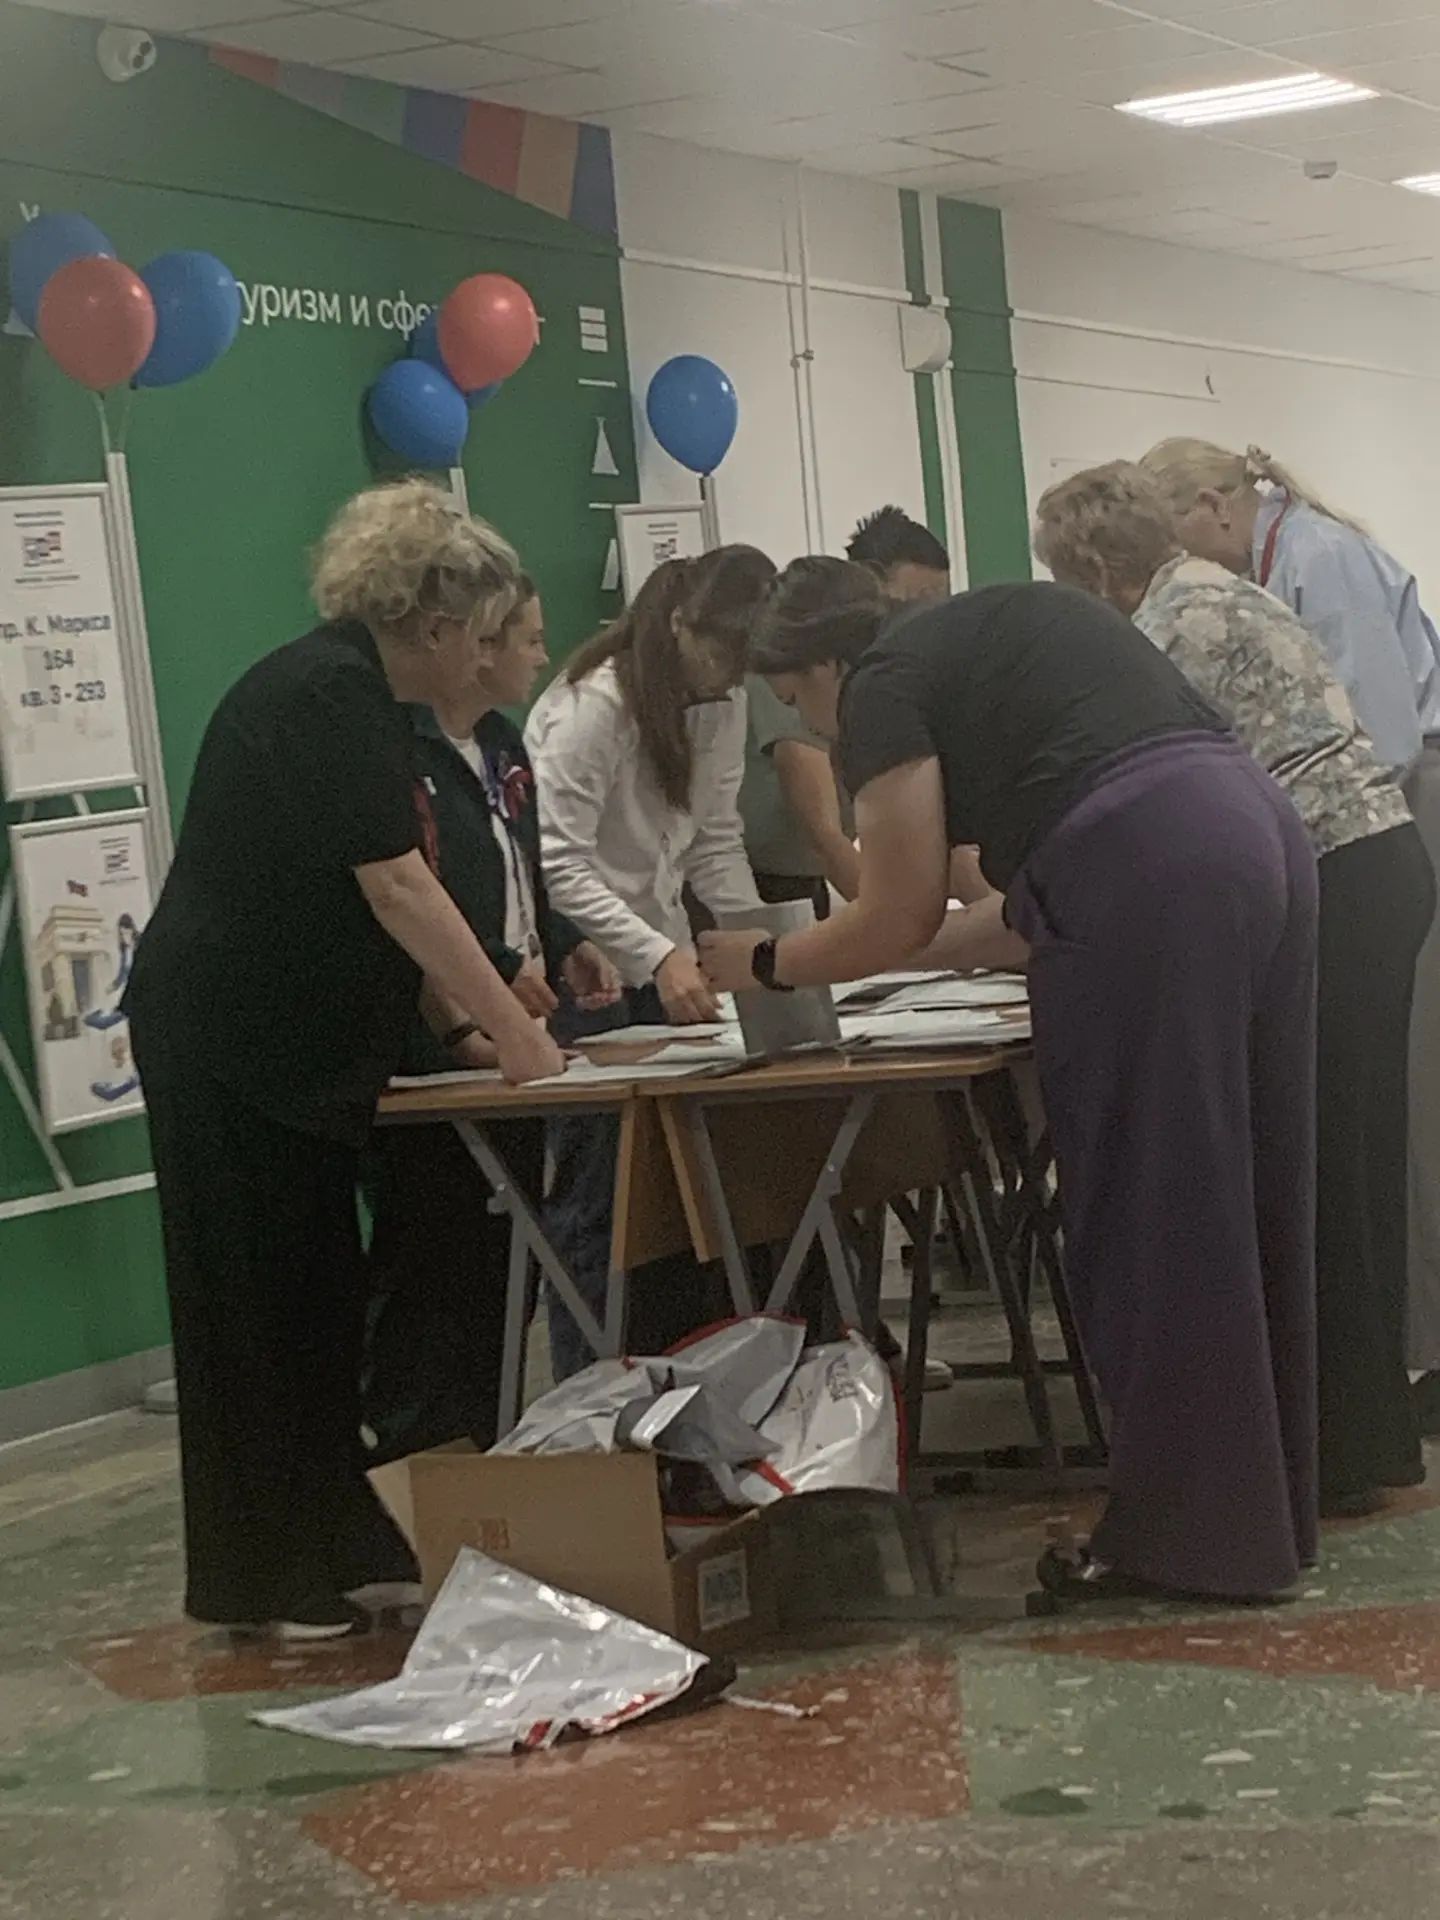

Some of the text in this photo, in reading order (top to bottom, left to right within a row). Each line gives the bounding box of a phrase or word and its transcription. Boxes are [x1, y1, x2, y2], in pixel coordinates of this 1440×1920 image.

[236, 281, 438, 342] уризм и сфе
